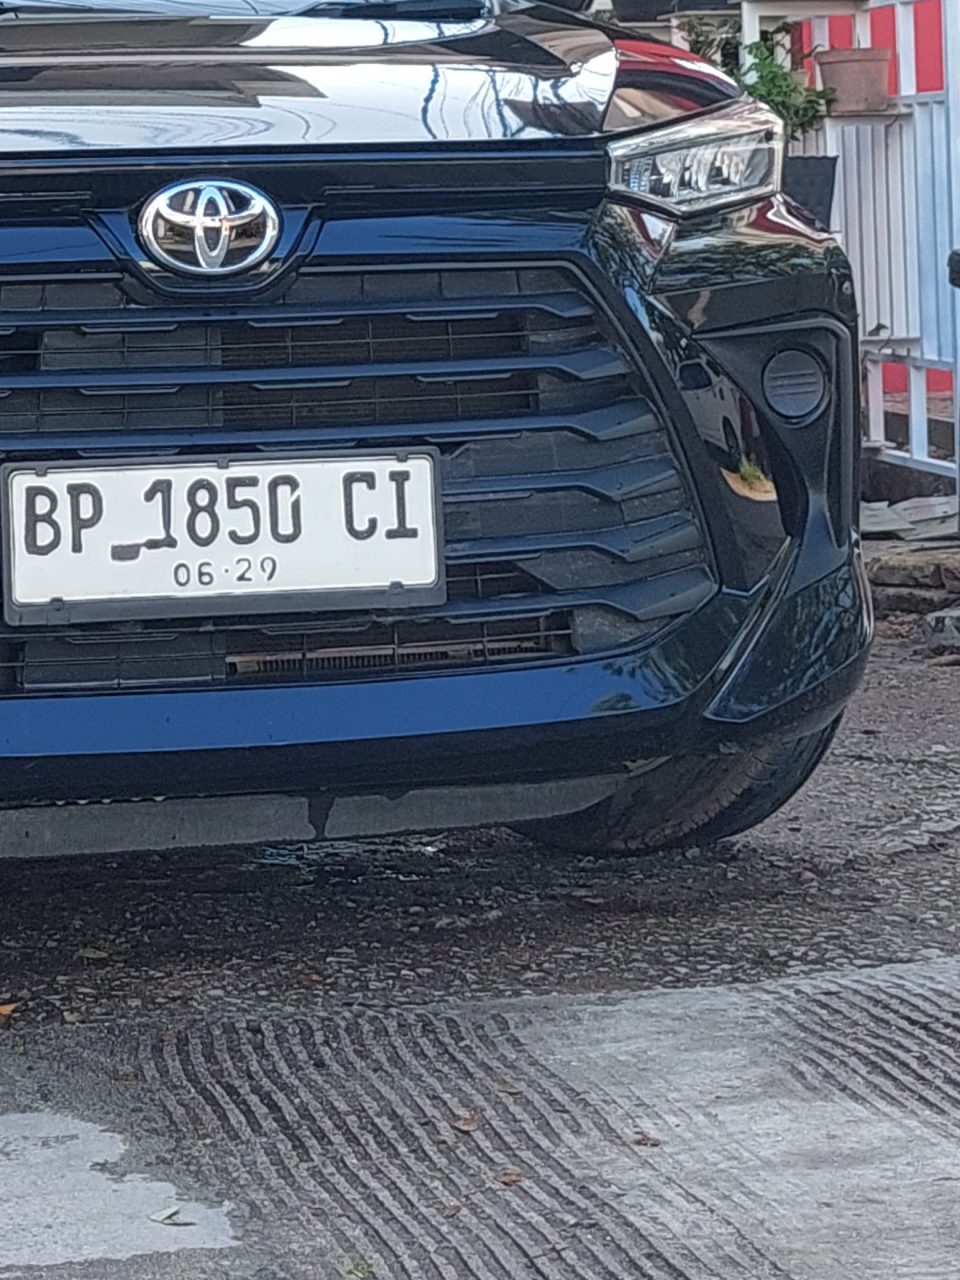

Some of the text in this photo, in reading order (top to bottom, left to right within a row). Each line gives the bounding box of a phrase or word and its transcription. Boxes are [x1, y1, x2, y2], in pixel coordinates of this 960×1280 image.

[24, 470, 419, 556] BP 1850 CI
